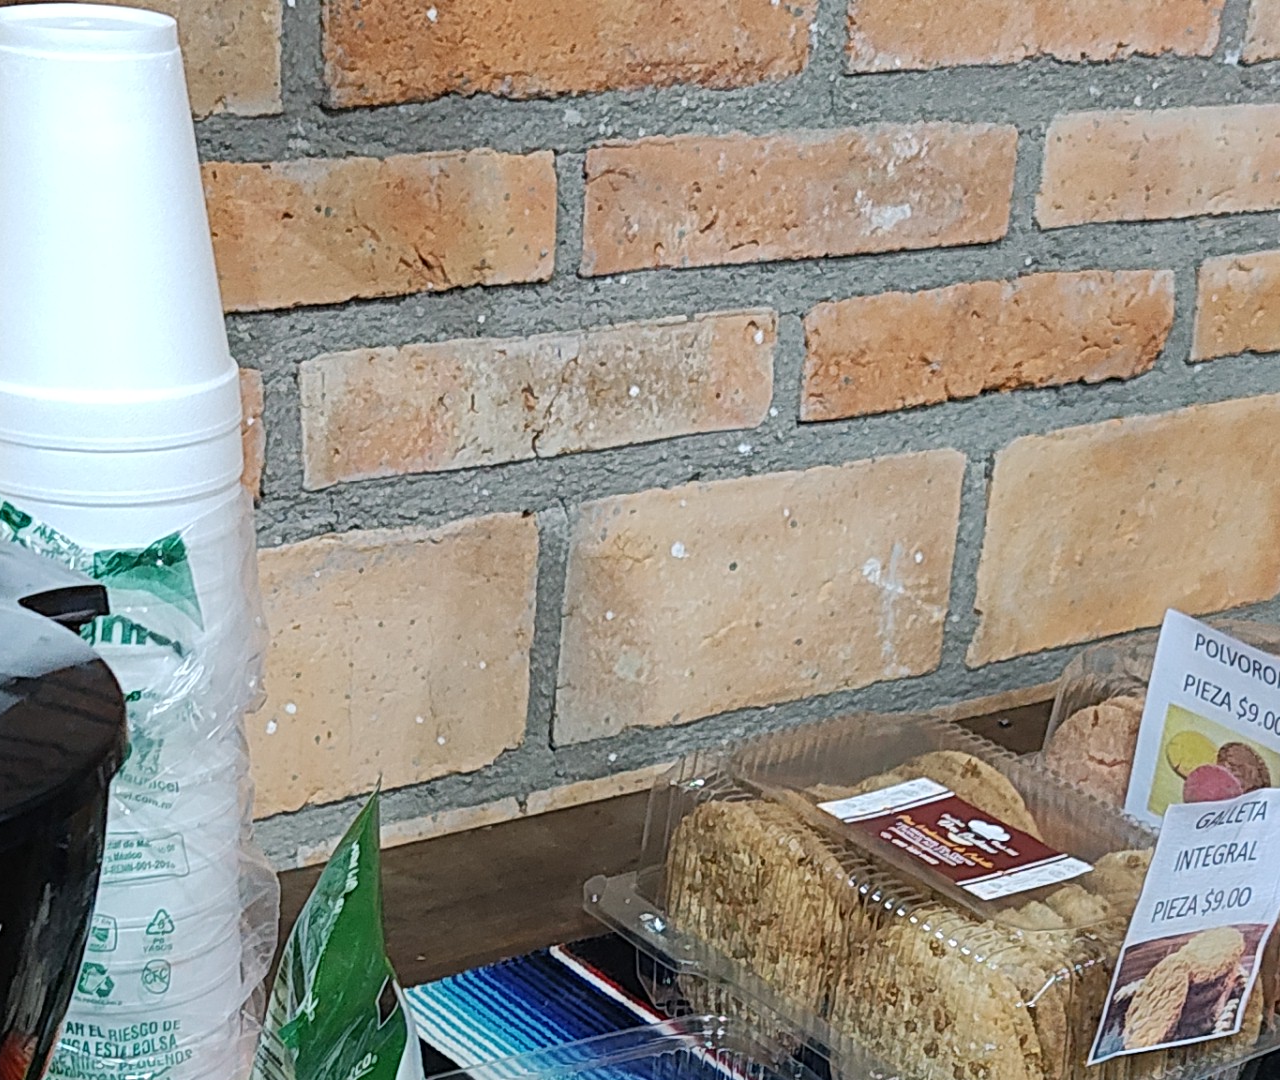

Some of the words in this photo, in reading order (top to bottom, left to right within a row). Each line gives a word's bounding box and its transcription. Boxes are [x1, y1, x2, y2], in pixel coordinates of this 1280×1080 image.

[1183, 673, 1232, 713] PIEZA
[1195, 800, 1269, 830] GALLETA
[1173, 840, 1258, 873] INTEGRAL
[1151, 894, 1198, 924] PIEZA
[1201, 886, 1253, 917] $9.00
[108, 1020, 158, 1042] RIESGO
[162, 1018, 182, 1032] DE
[132, 1033, 179, 1057] BOLSA
